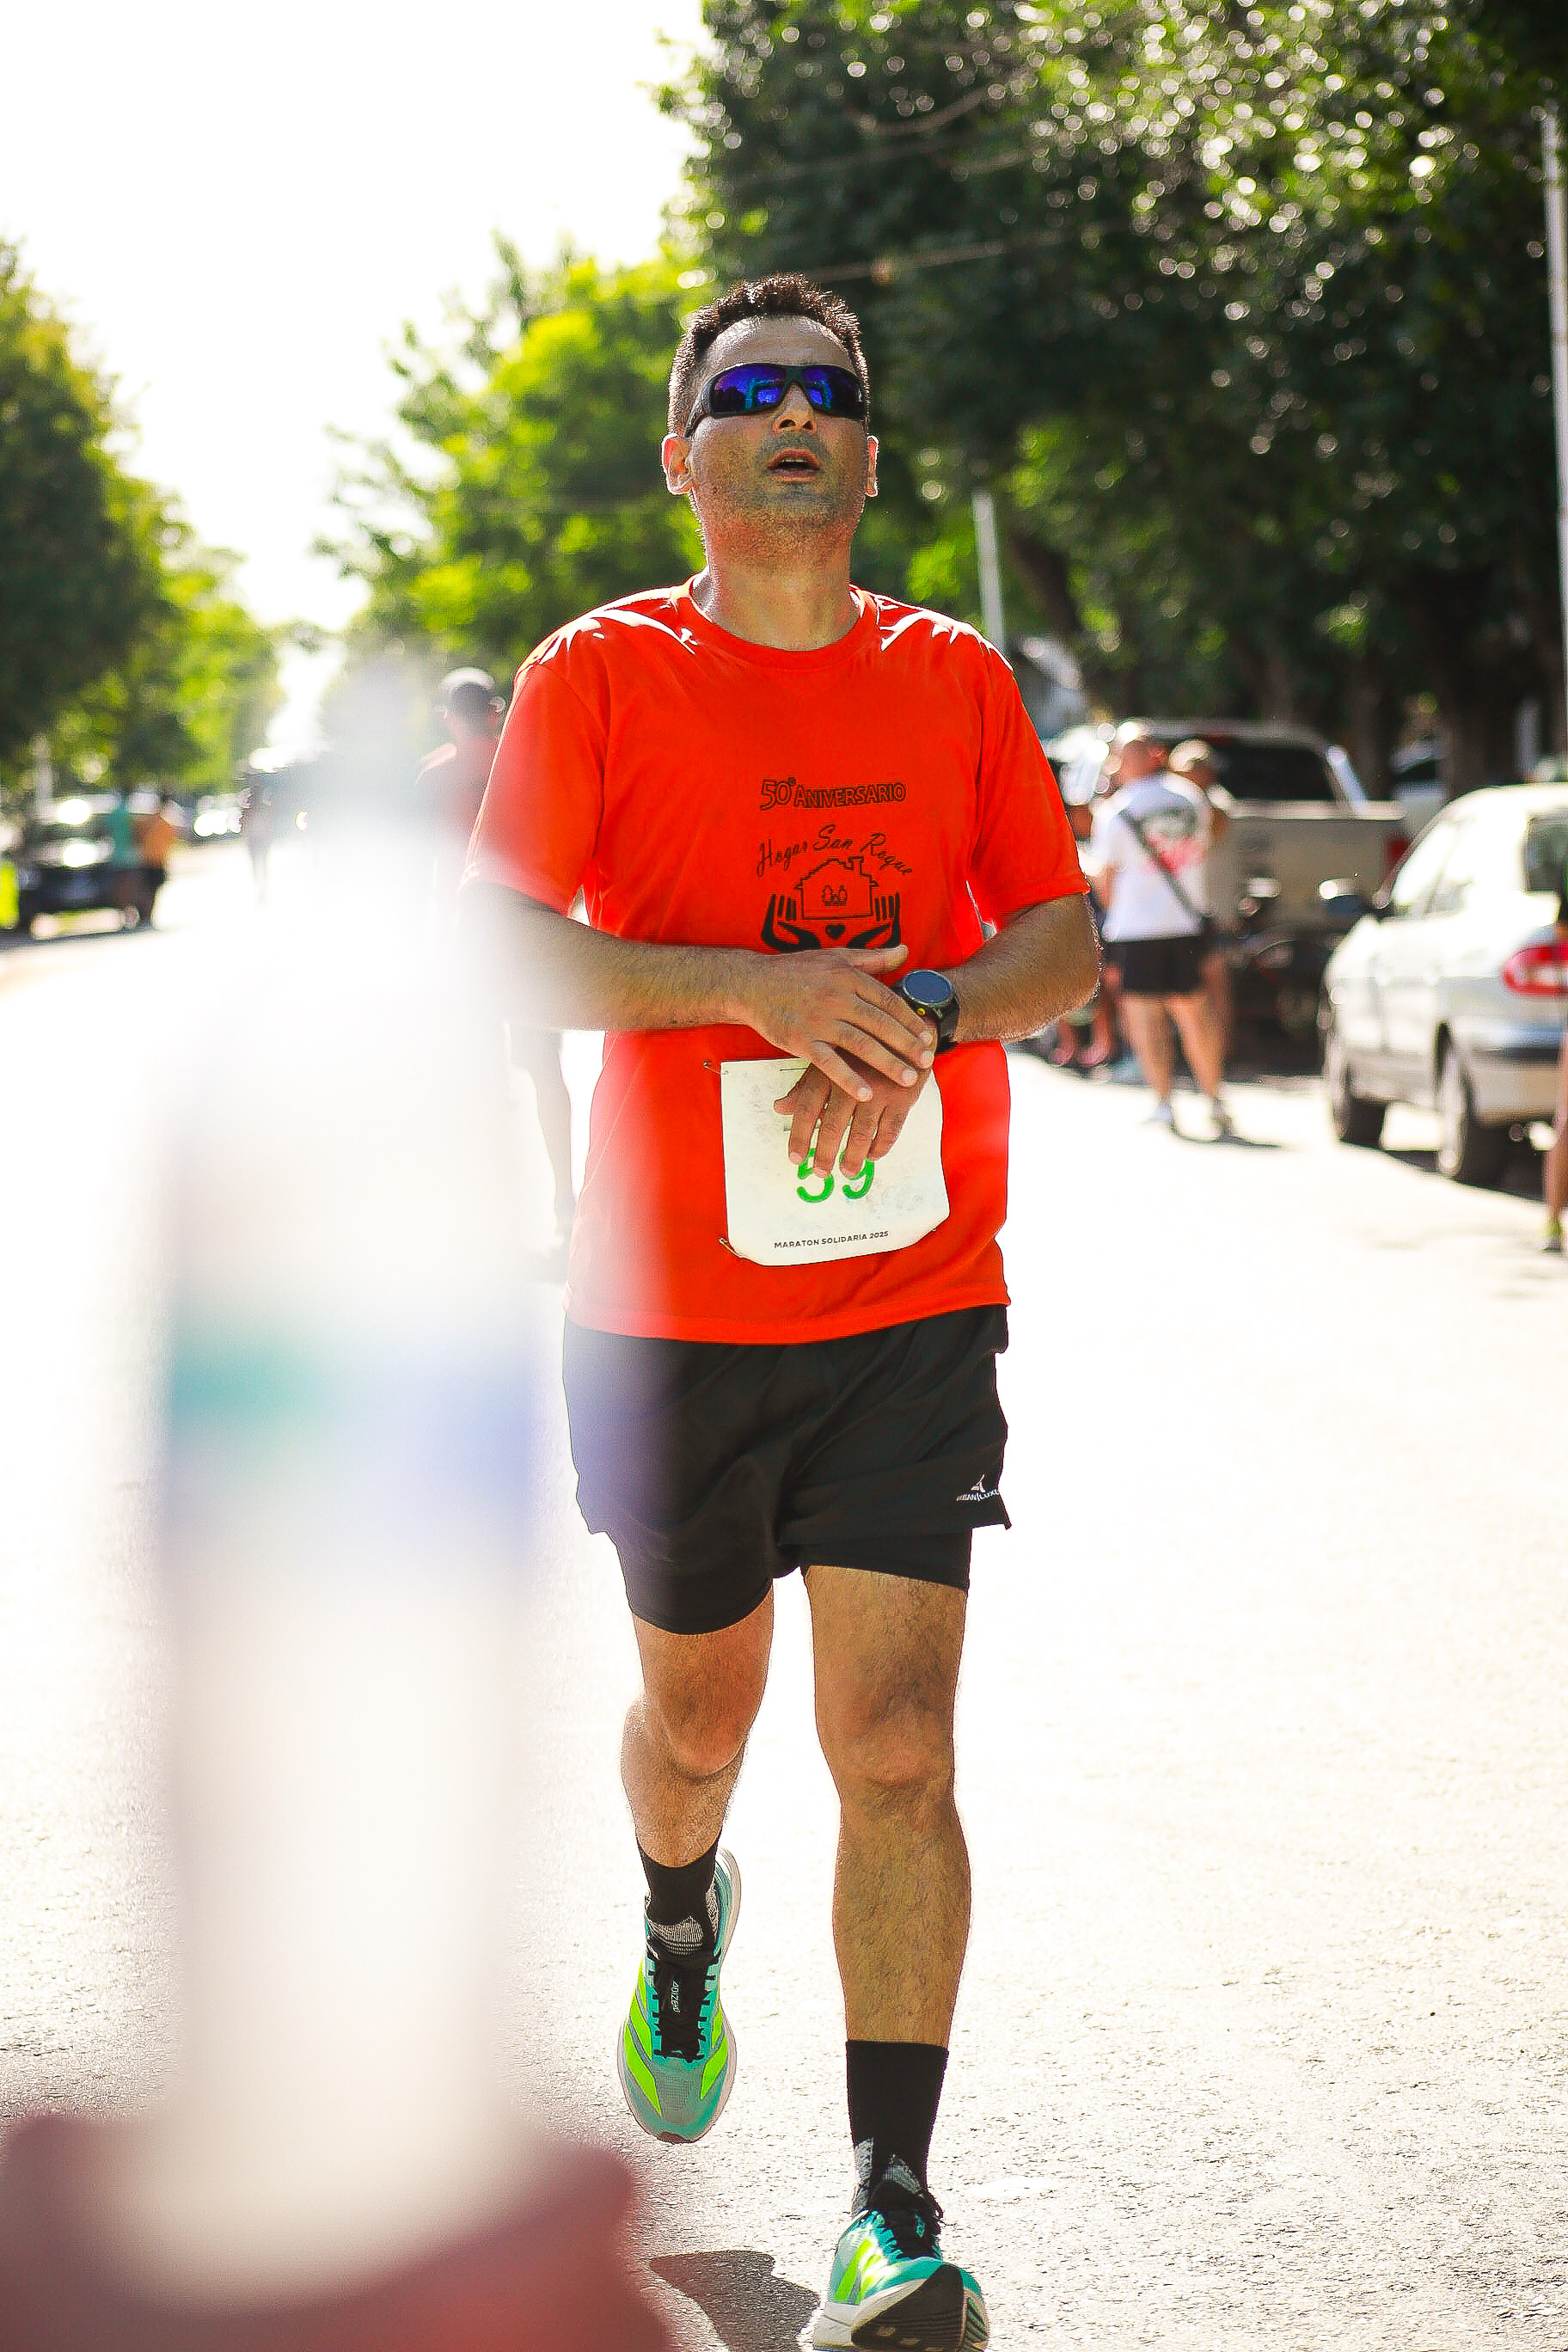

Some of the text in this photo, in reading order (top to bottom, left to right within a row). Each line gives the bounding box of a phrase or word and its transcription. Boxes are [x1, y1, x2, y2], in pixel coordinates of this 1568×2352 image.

[793, 781, 907, 809] ANIVERSARIO
[756, 823, 913, 877] Hogar San Roque
[774, 1230, 889, 1249] MARATON SOLIDARIA 2025
